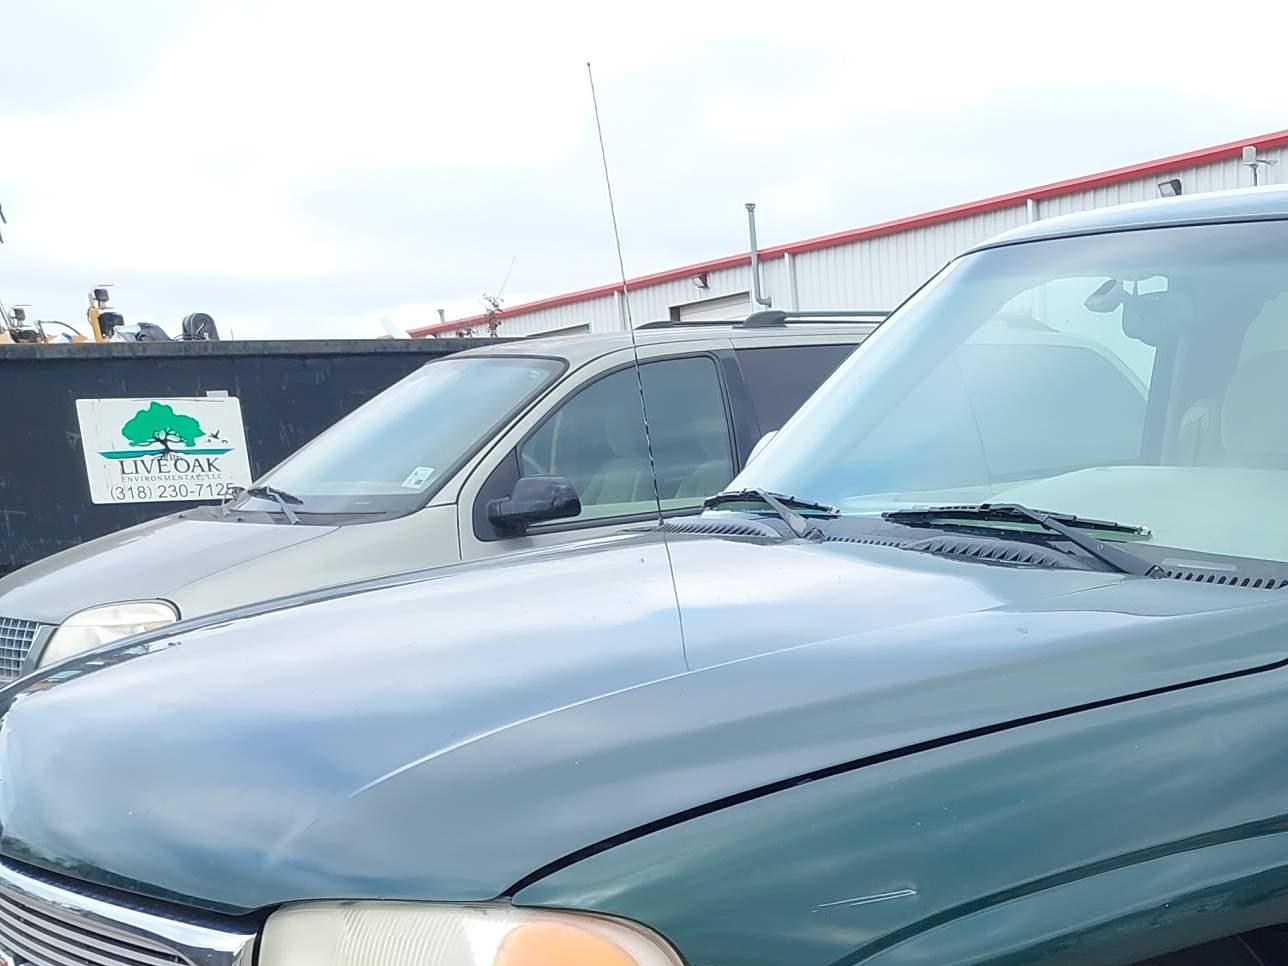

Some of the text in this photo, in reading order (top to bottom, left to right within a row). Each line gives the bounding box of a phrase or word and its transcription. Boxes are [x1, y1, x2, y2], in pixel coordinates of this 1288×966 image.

[119, 457, 222, 475] LIVE OAK
[207, 472, 223, 480] LLC
[110, 484, 153, 501] (318)
